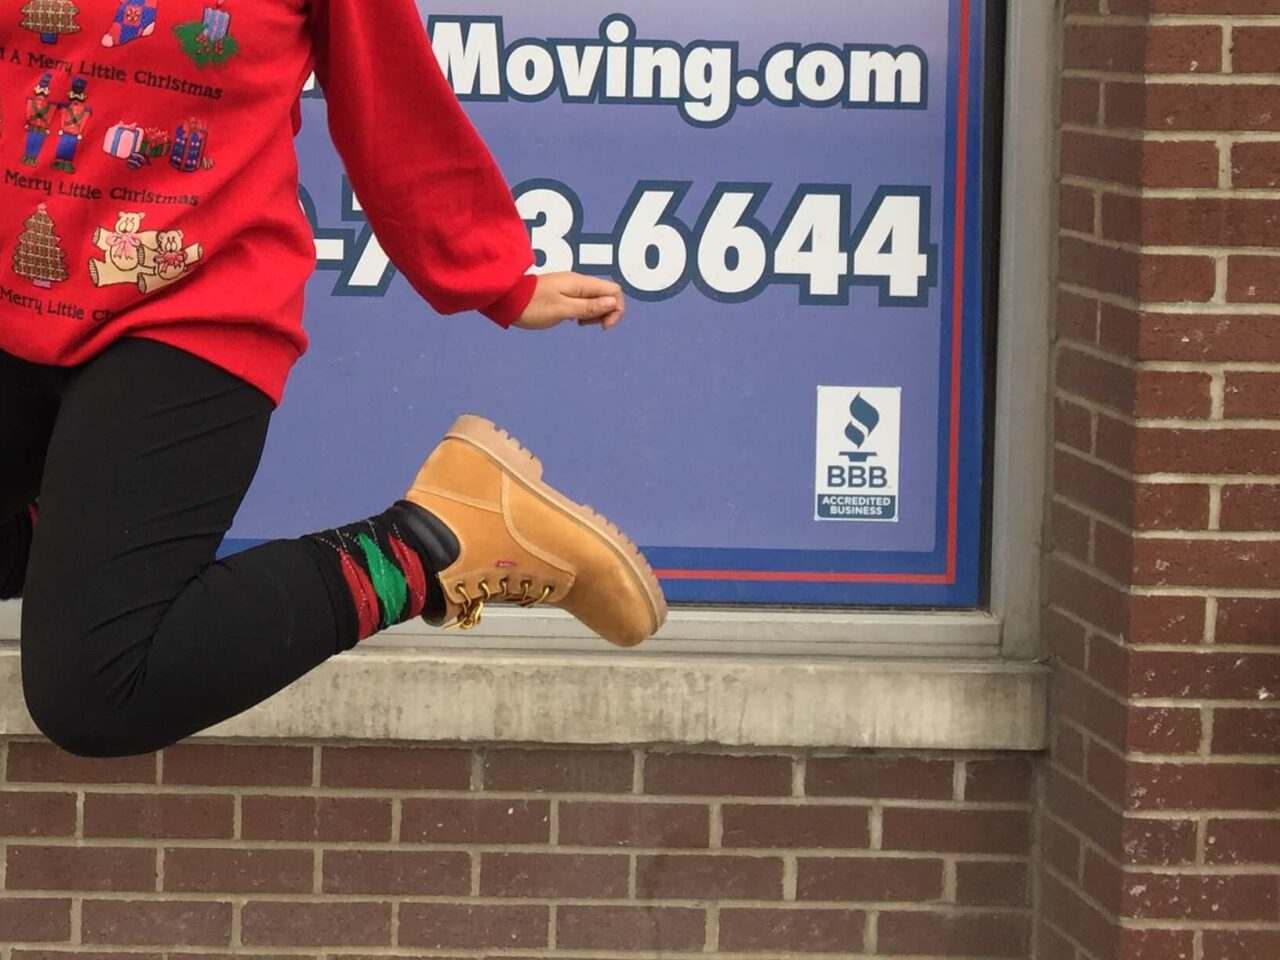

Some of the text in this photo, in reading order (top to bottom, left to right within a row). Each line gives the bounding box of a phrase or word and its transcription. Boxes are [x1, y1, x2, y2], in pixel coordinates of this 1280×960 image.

[9, 49, 22, 65] A
[27, 52, 74, 76] Merry
[78, 60, 127, 82] Little
[133, 70, 223, 100] Christmas
[431, 19, 923, 123] Moving.com
[4, 169, 52, 196] Merry
[58, 181, 102, 200] Little
[108, 186, 200, 207] Christmas
[313, 187, 929, 298] -3-6644
[0, 284, 43, 315] Merry
[47, 299, 85, 321] Little
[826, 465, 888, 489] BBB
[821, 495, 891, 506] ACCREDITED
[829, 506, 883, 516] BUSINESS
